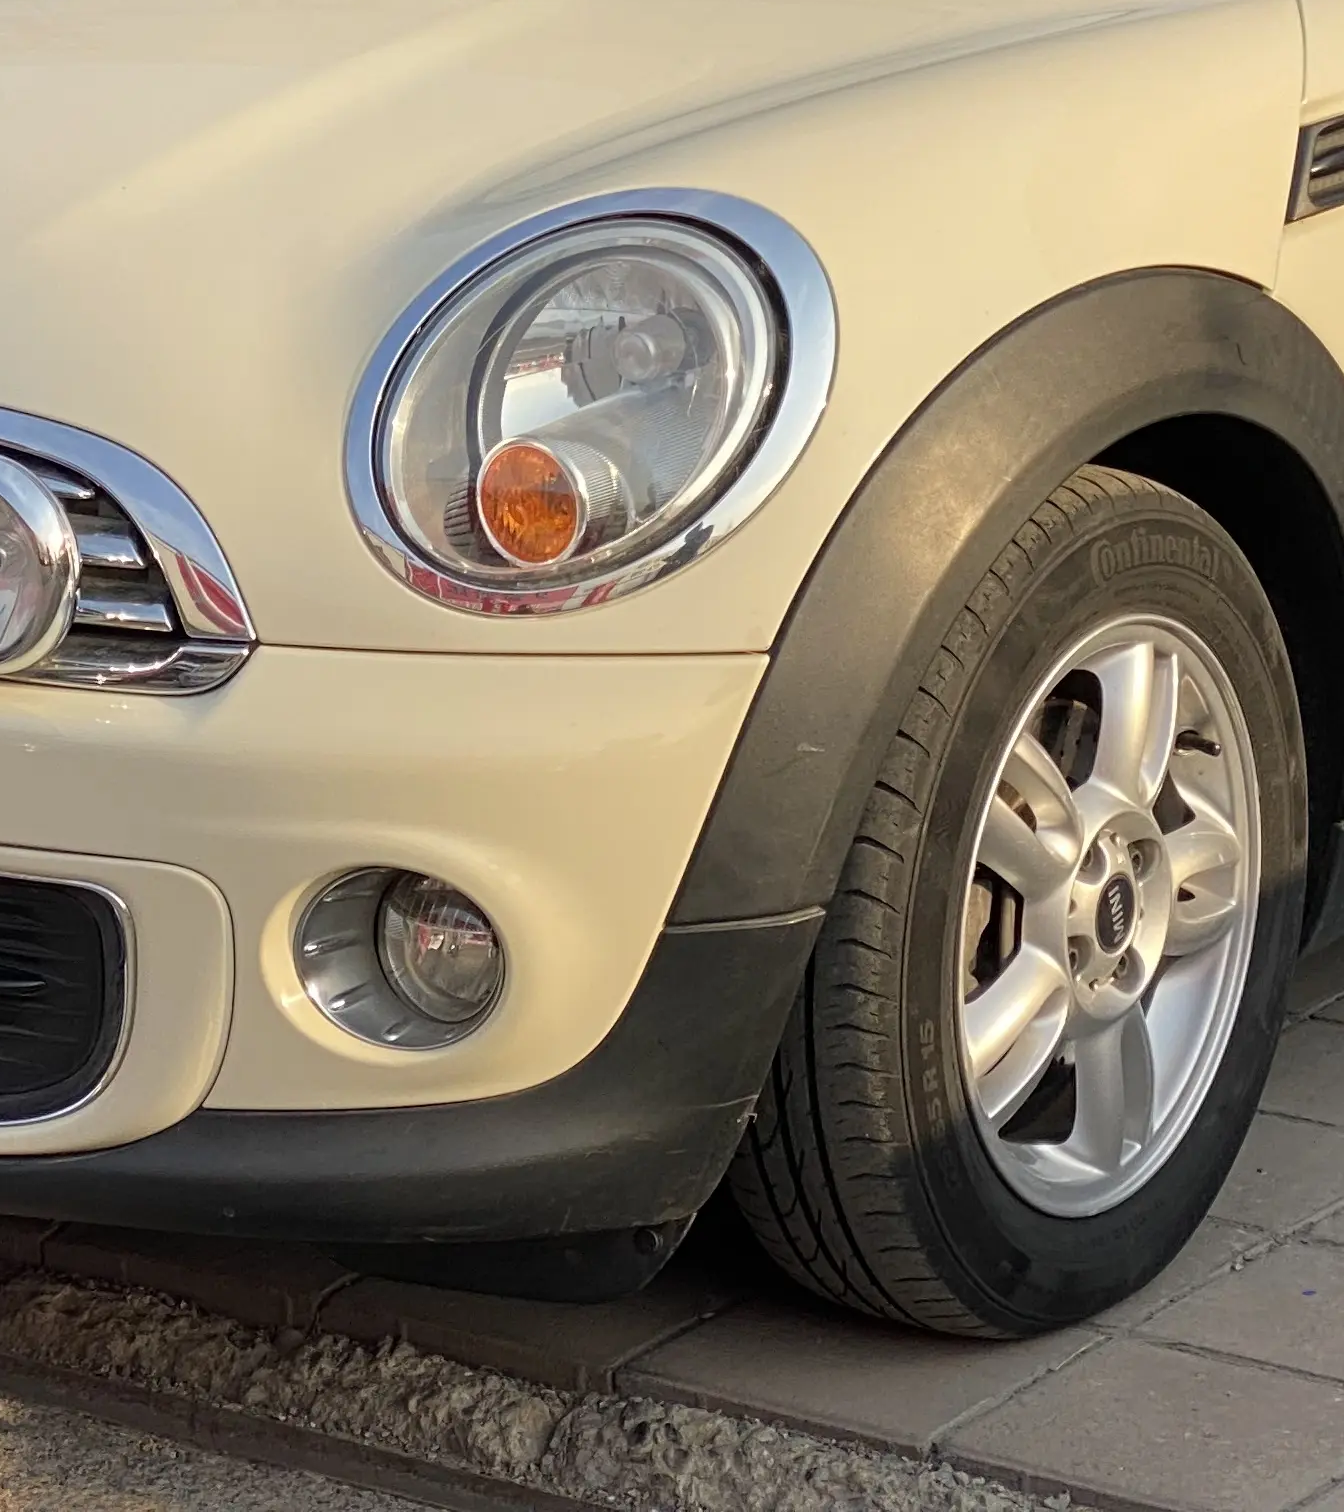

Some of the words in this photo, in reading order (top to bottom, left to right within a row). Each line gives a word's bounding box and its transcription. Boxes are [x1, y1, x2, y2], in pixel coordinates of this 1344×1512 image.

[1090, 526, 1219, 587] Continental
[1108, 885, 1126, 944] MINI
[919, 1018, 935, 1060] 15
